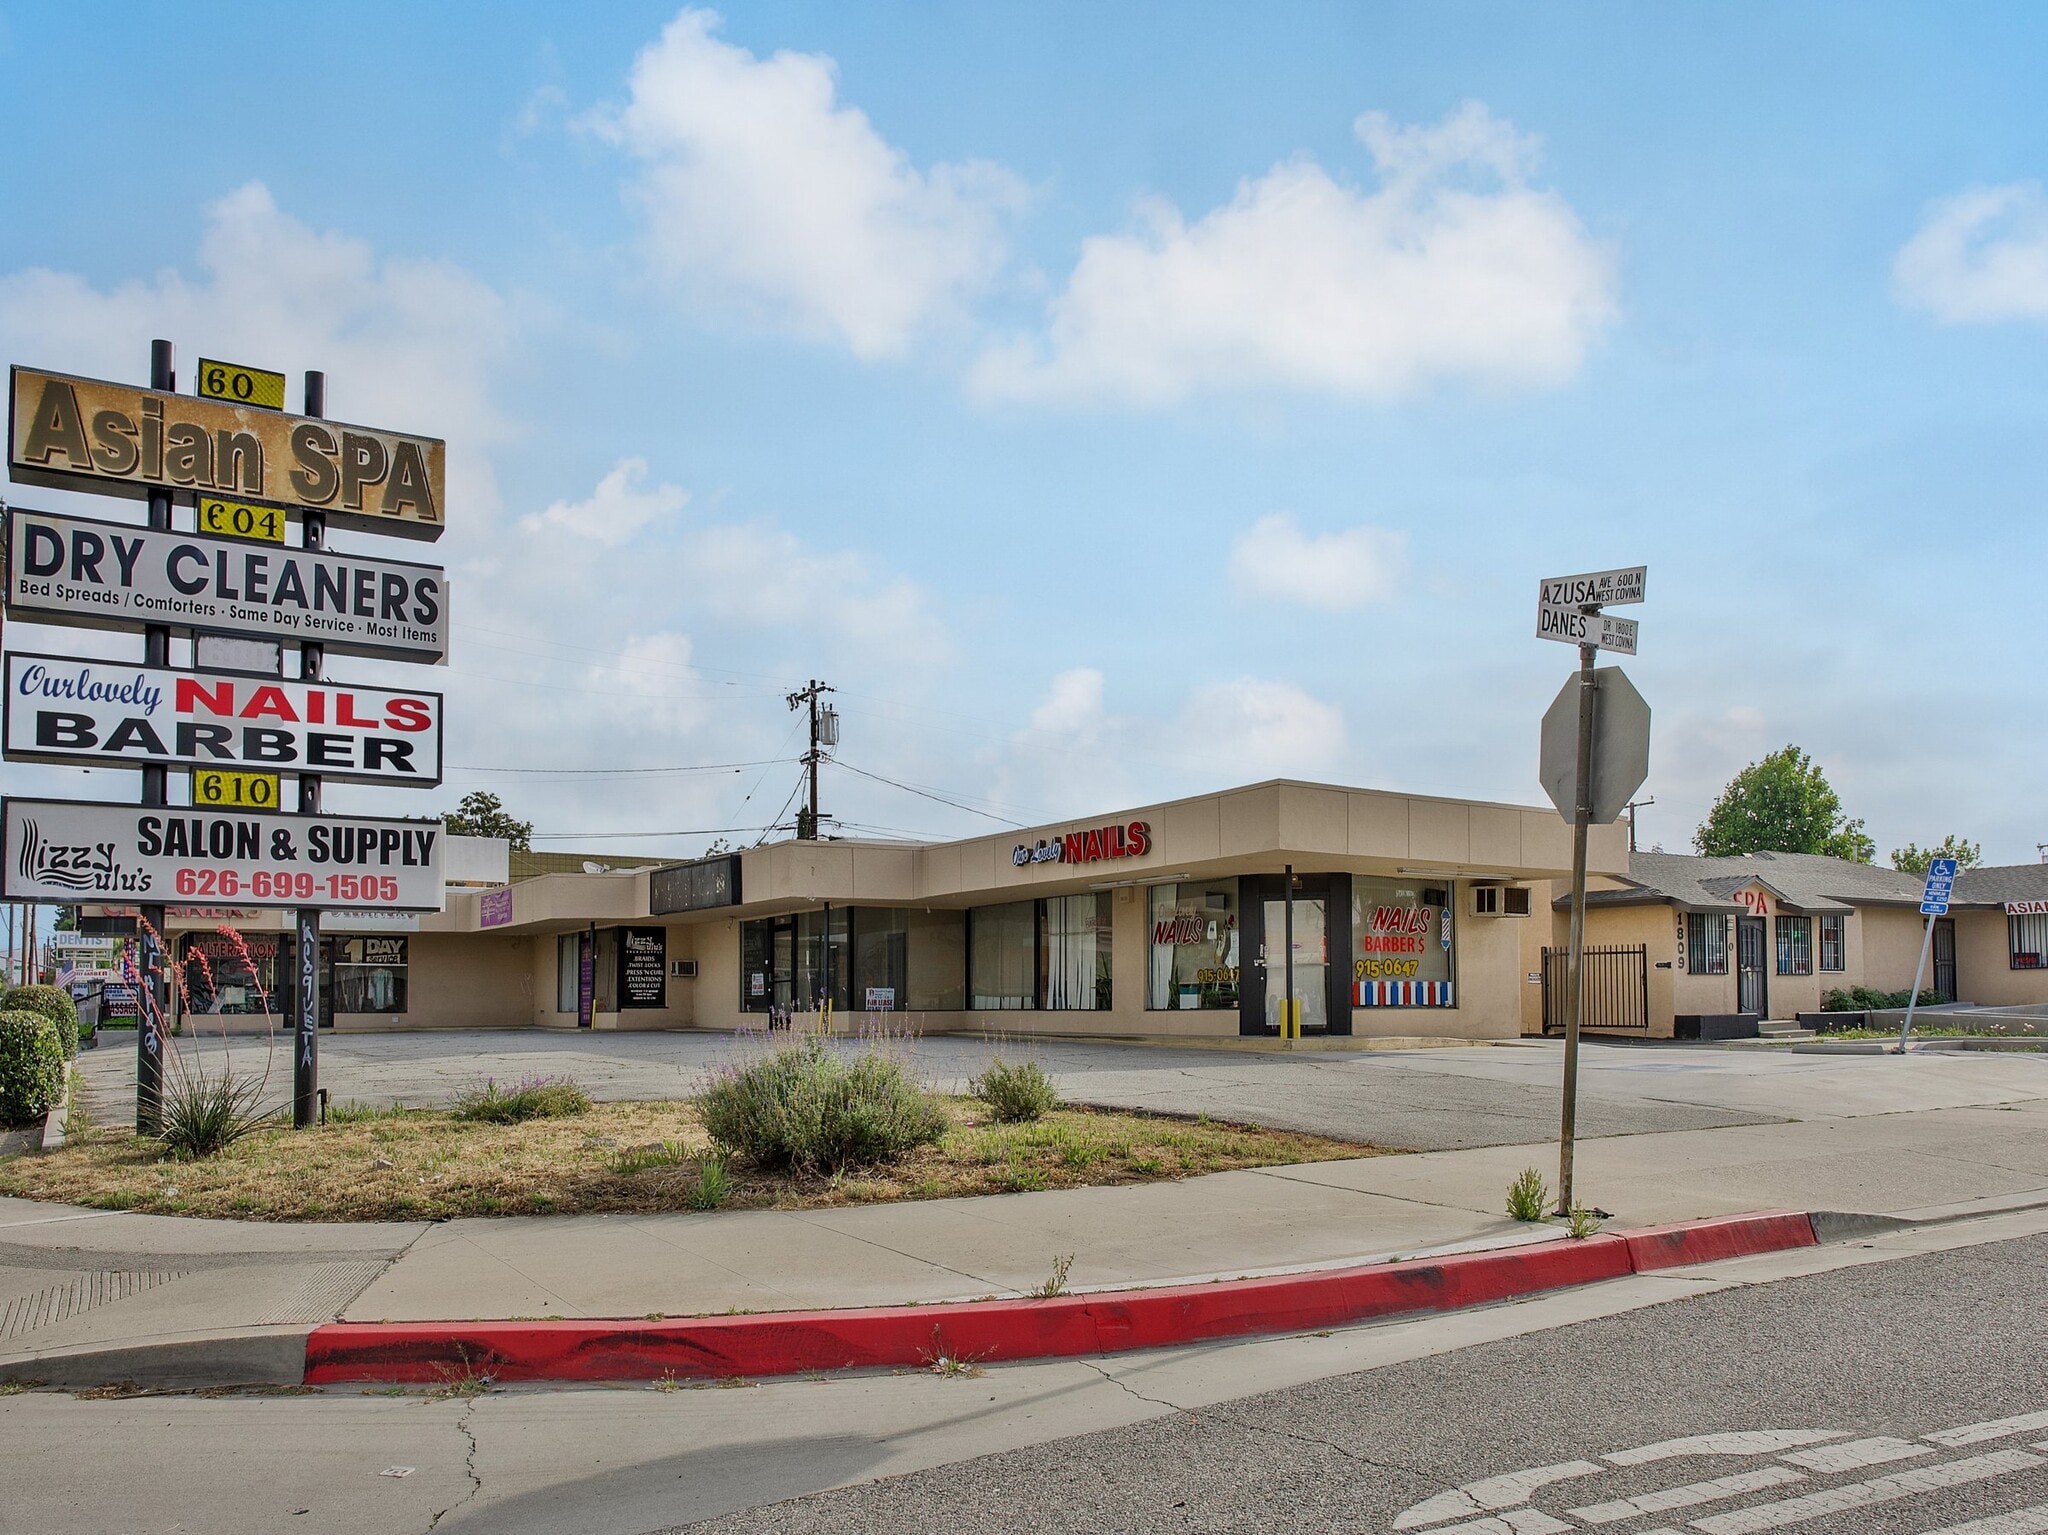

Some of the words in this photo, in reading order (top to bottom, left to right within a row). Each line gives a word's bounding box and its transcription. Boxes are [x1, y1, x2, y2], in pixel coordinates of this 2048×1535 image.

[207, 368, 254, 399] 60
[23, 379, 264, 497] Asian
[289, 423, 438, 521] SPA
[24, 523, 145, 588] DRY
[165, 544, 440, 626] CLEANERS
[1541, 580, 1596, 604] AZUSA
[1599, 576, 1612, 589] AVE
[1617, 574, 1634, 587] 600
[1634, 572, 1641, 584] N
[1595, 588, 1615, 602] WEST
[1615, 586, 1641, 600] COVINA
[20, 580, 50, 597] Bed
[56, 584, 120, 605] Spreads
[134, 593, 216, 616] Comforters
[229, 605, 268, 623] Same
[273, 611, 301, 631] Day
[304, 614, 354, 633] Service
[366, 622, 398, 639] Most
[402, 626, 438, 643] Items
[1541, 609, 1587, 638] DANES
[1603, 619, 1611, 632] DR
[1601, 632, 1615, 646] WEST
[1615, 636, 1634, 649] COVINA
[19, 664, 162, 716] Ourlovely
[175, 677, 431, 732] NAILS
[36, 710, 417, 773] BARBER
[203, 774, 271, 804] 610
[137, 816, 260, 860] SALON
[270, 828, 297, 861] &
[308, 825, 436, 867] SUPPLY
[1012, 844, 1029, 866] Our
[1030, 838, 1061, 864] Lovely
[1065, 821, 1146, 865] NAILS
[175, 869, 399, 901] 626-699-1505
[1929, 875, 1953, 883] PARKING
[1152, 917, 1203, 946] NAILS
[1372, 906, 1431, 935] NAILS
[198, 943, 276, 957] ALTERATION
[366, 940, 404, 954] DAY
[1364, 935, 1415, 953] BARBER
[1356, 958, 1419, 979] 915-0647
